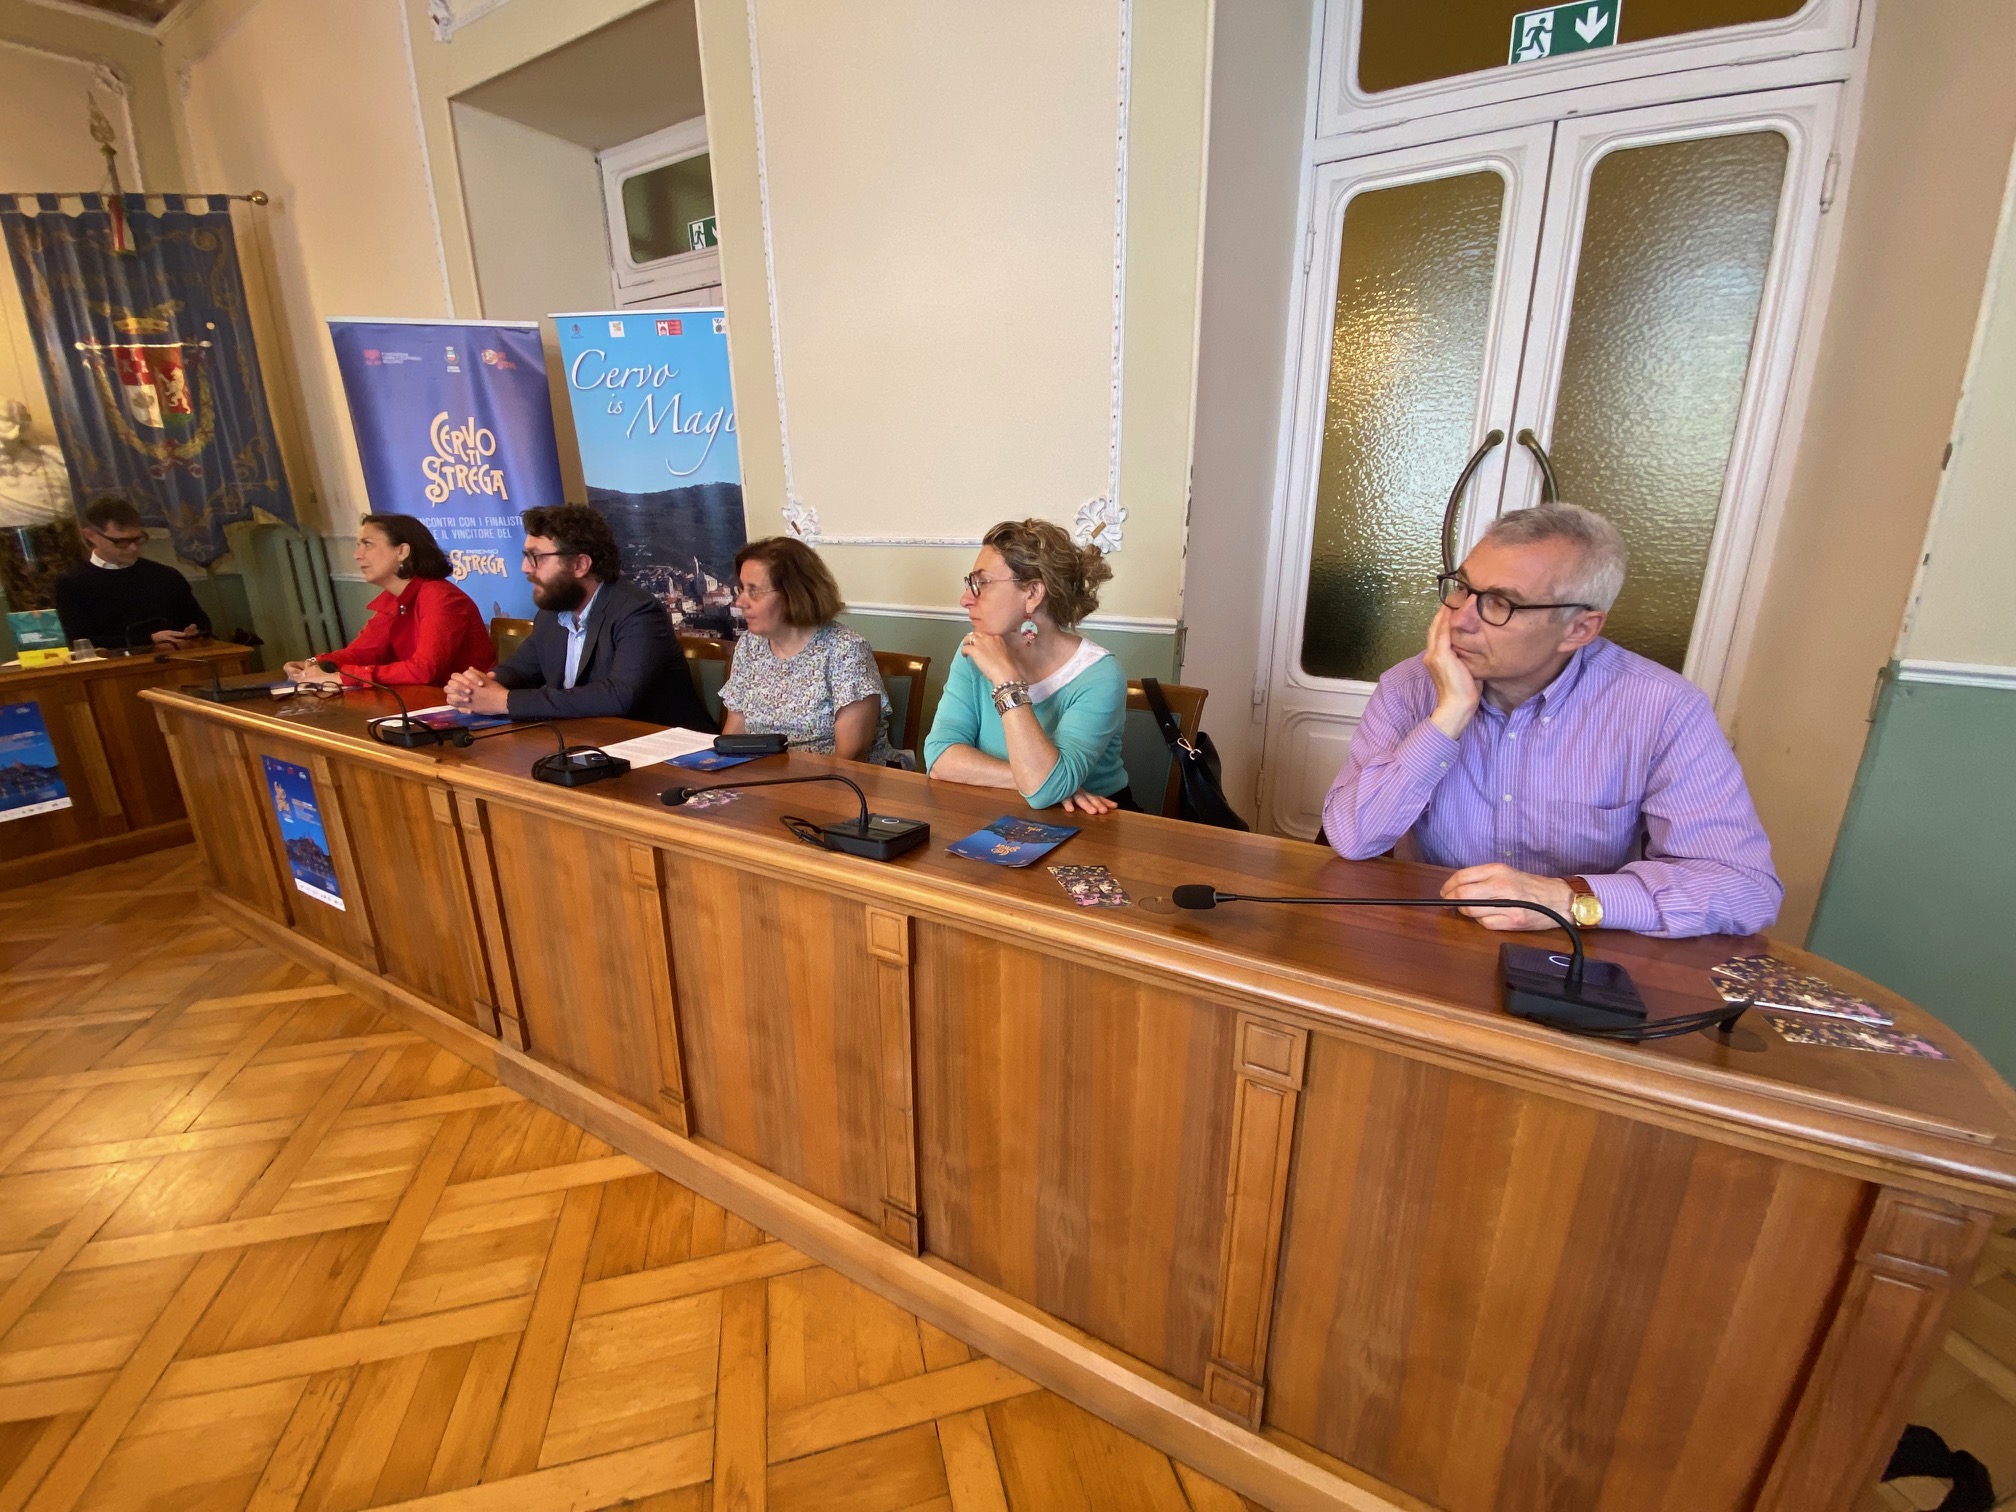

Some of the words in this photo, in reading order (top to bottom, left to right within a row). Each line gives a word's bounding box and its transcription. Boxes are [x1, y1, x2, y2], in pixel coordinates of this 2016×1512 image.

[571, 348, 679, 390] Cervo
[607, 393, 623, 414] is
[430, 411, 496, 463] CERVO
[467, 449, 482, 466] TI
[422, 456, 509, 508] STREGA
[416, 517, 456, 528] NCONTRI
[458, 517, 476, 527] CON
[479, 517, 482, 527] I
[432, 529, 439, 540] E
[441, 529, 449, 540] IL
[451, 528, 495, 539] VINCITORE
[497, 528, 512, 539] DEL
[450, 549, 508, 584] STREGA
